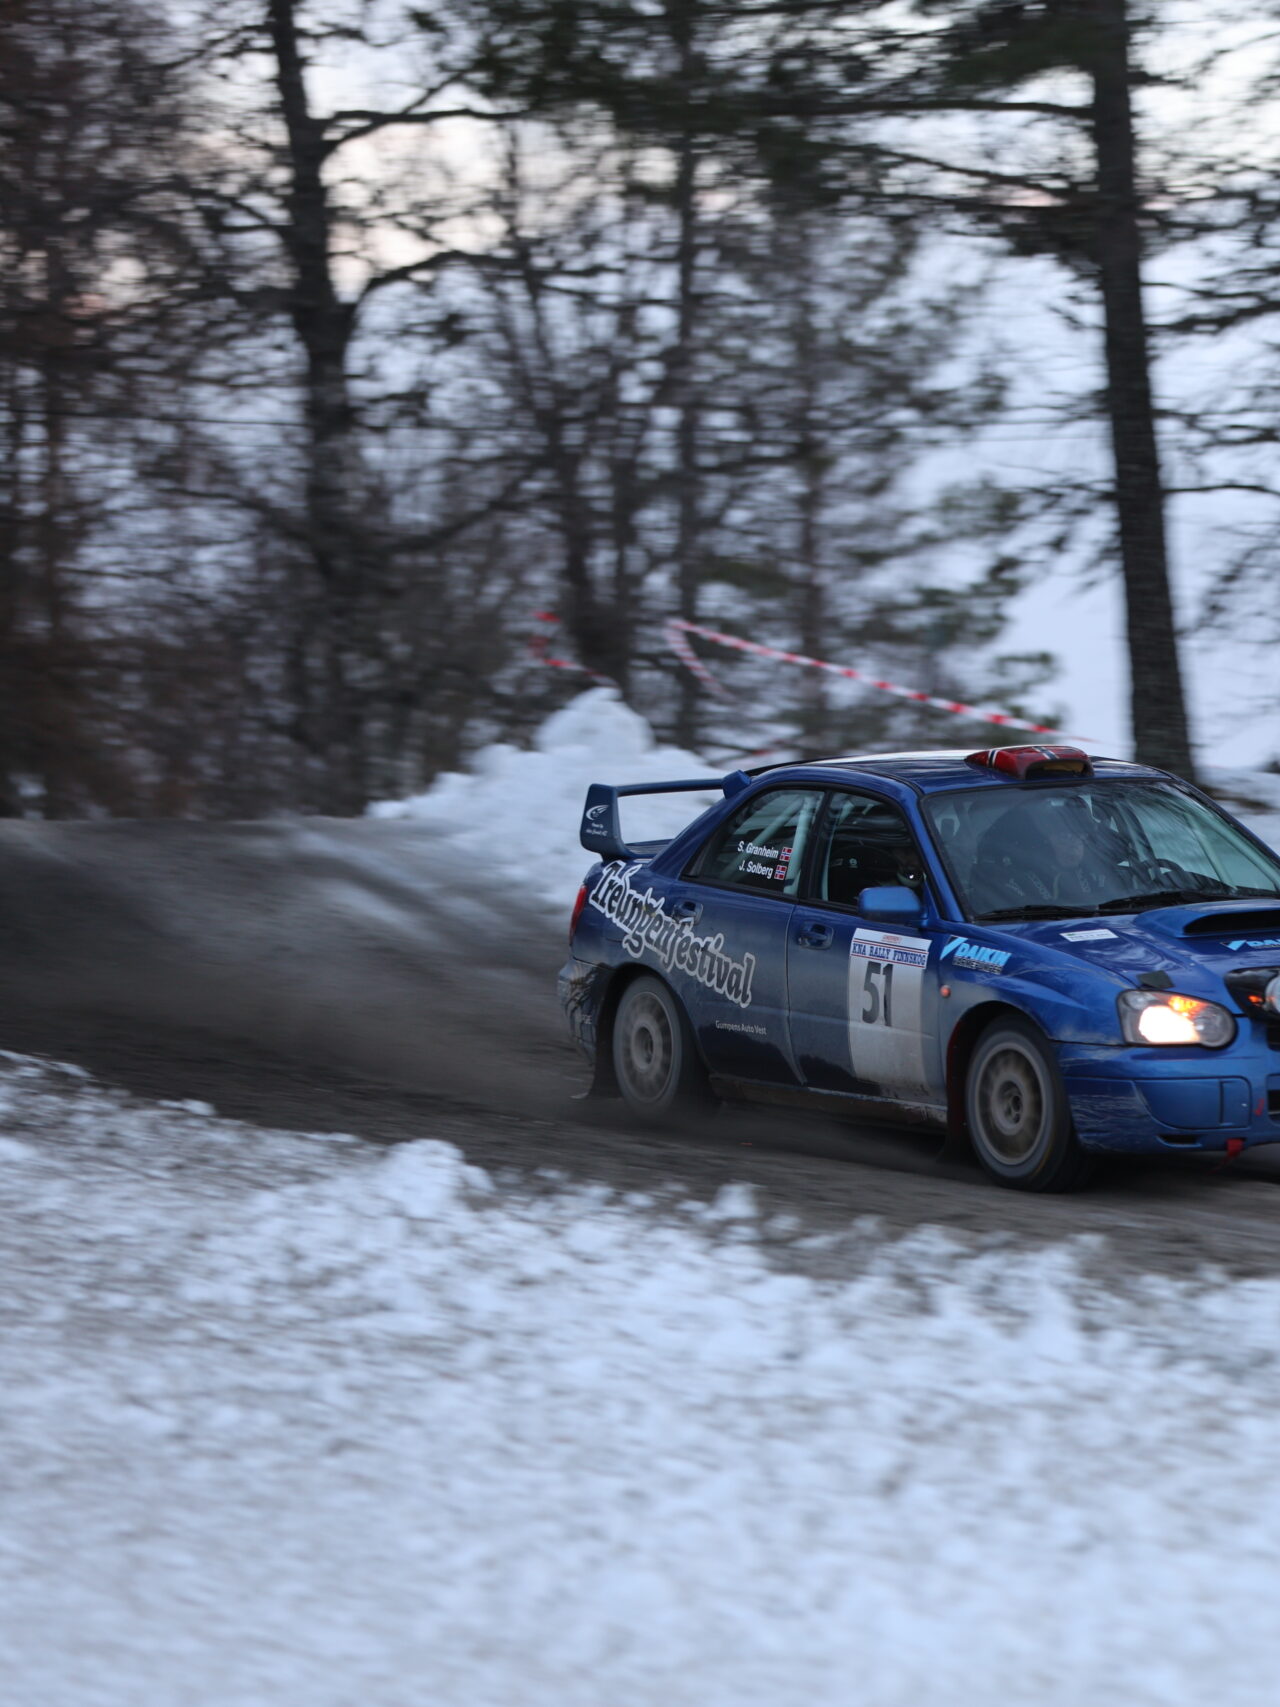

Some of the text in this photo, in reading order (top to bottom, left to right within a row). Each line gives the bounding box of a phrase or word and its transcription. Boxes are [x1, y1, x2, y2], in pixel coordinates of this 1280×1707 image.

[738, 841, 779, 858] S. Granheim
[739, 860, 773, 879] J. Solberg
[852, 943, 926, 965] KNA RALLY FINNSKOG
[954, 942, 1012, 966] DAIKIN
[862, 961, 893, 1027] 51
